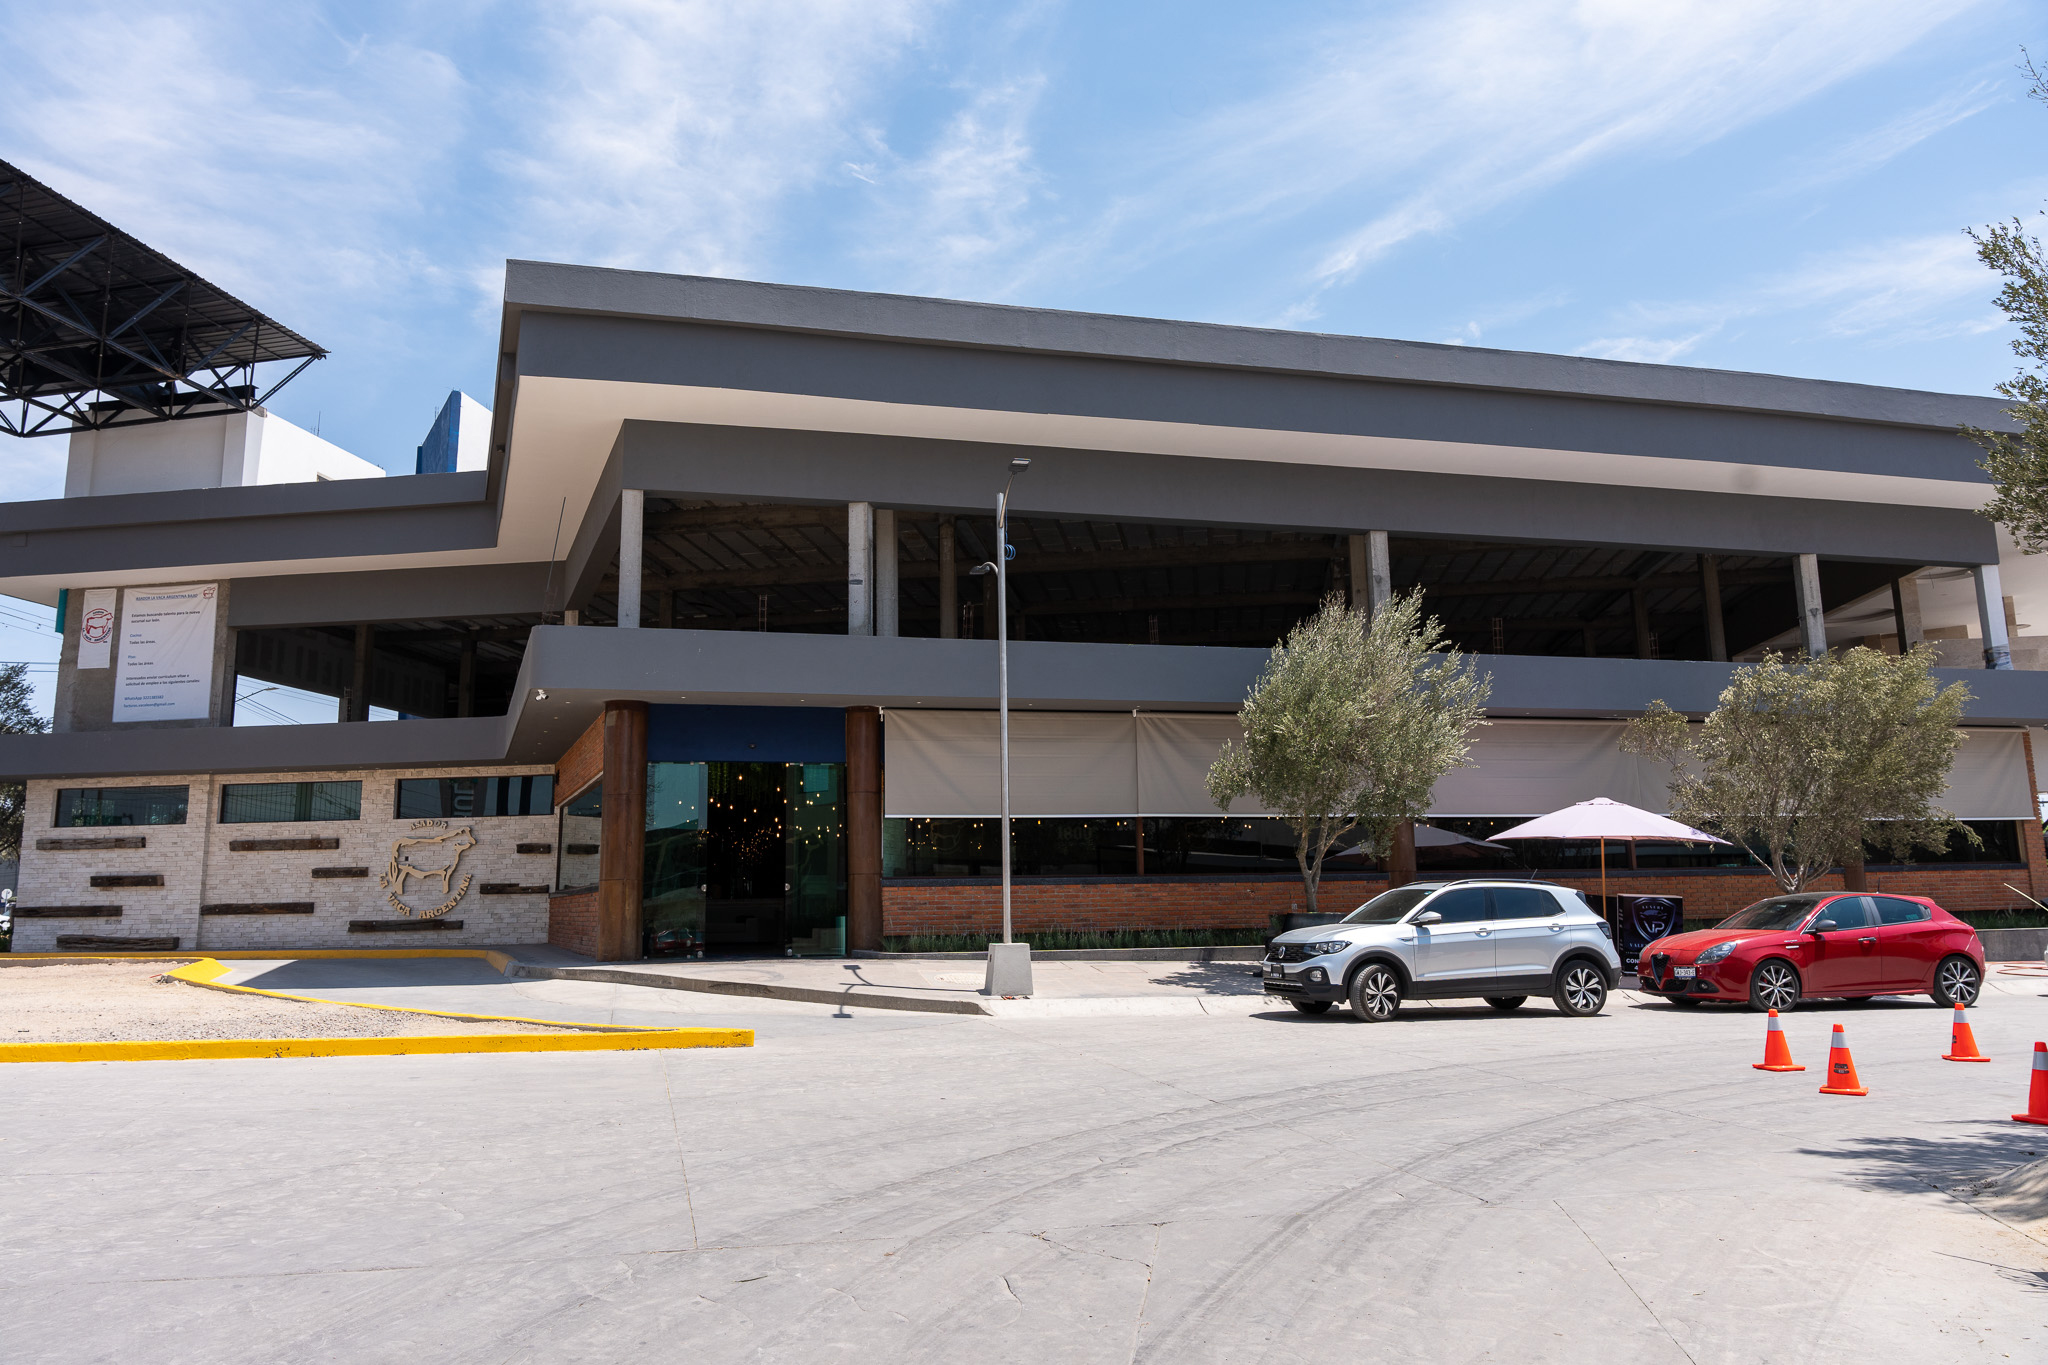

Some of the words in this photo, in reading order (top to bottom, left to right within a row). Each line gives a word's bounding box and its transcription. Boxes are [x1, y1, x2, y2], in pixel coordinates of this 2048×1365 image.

[410, 820, 448, 831] ASADOR
[379, 872, 389, 889] LA
[388, 890, 412, 916] VACA
[418, 872, 474, 920] ARGENTINA
